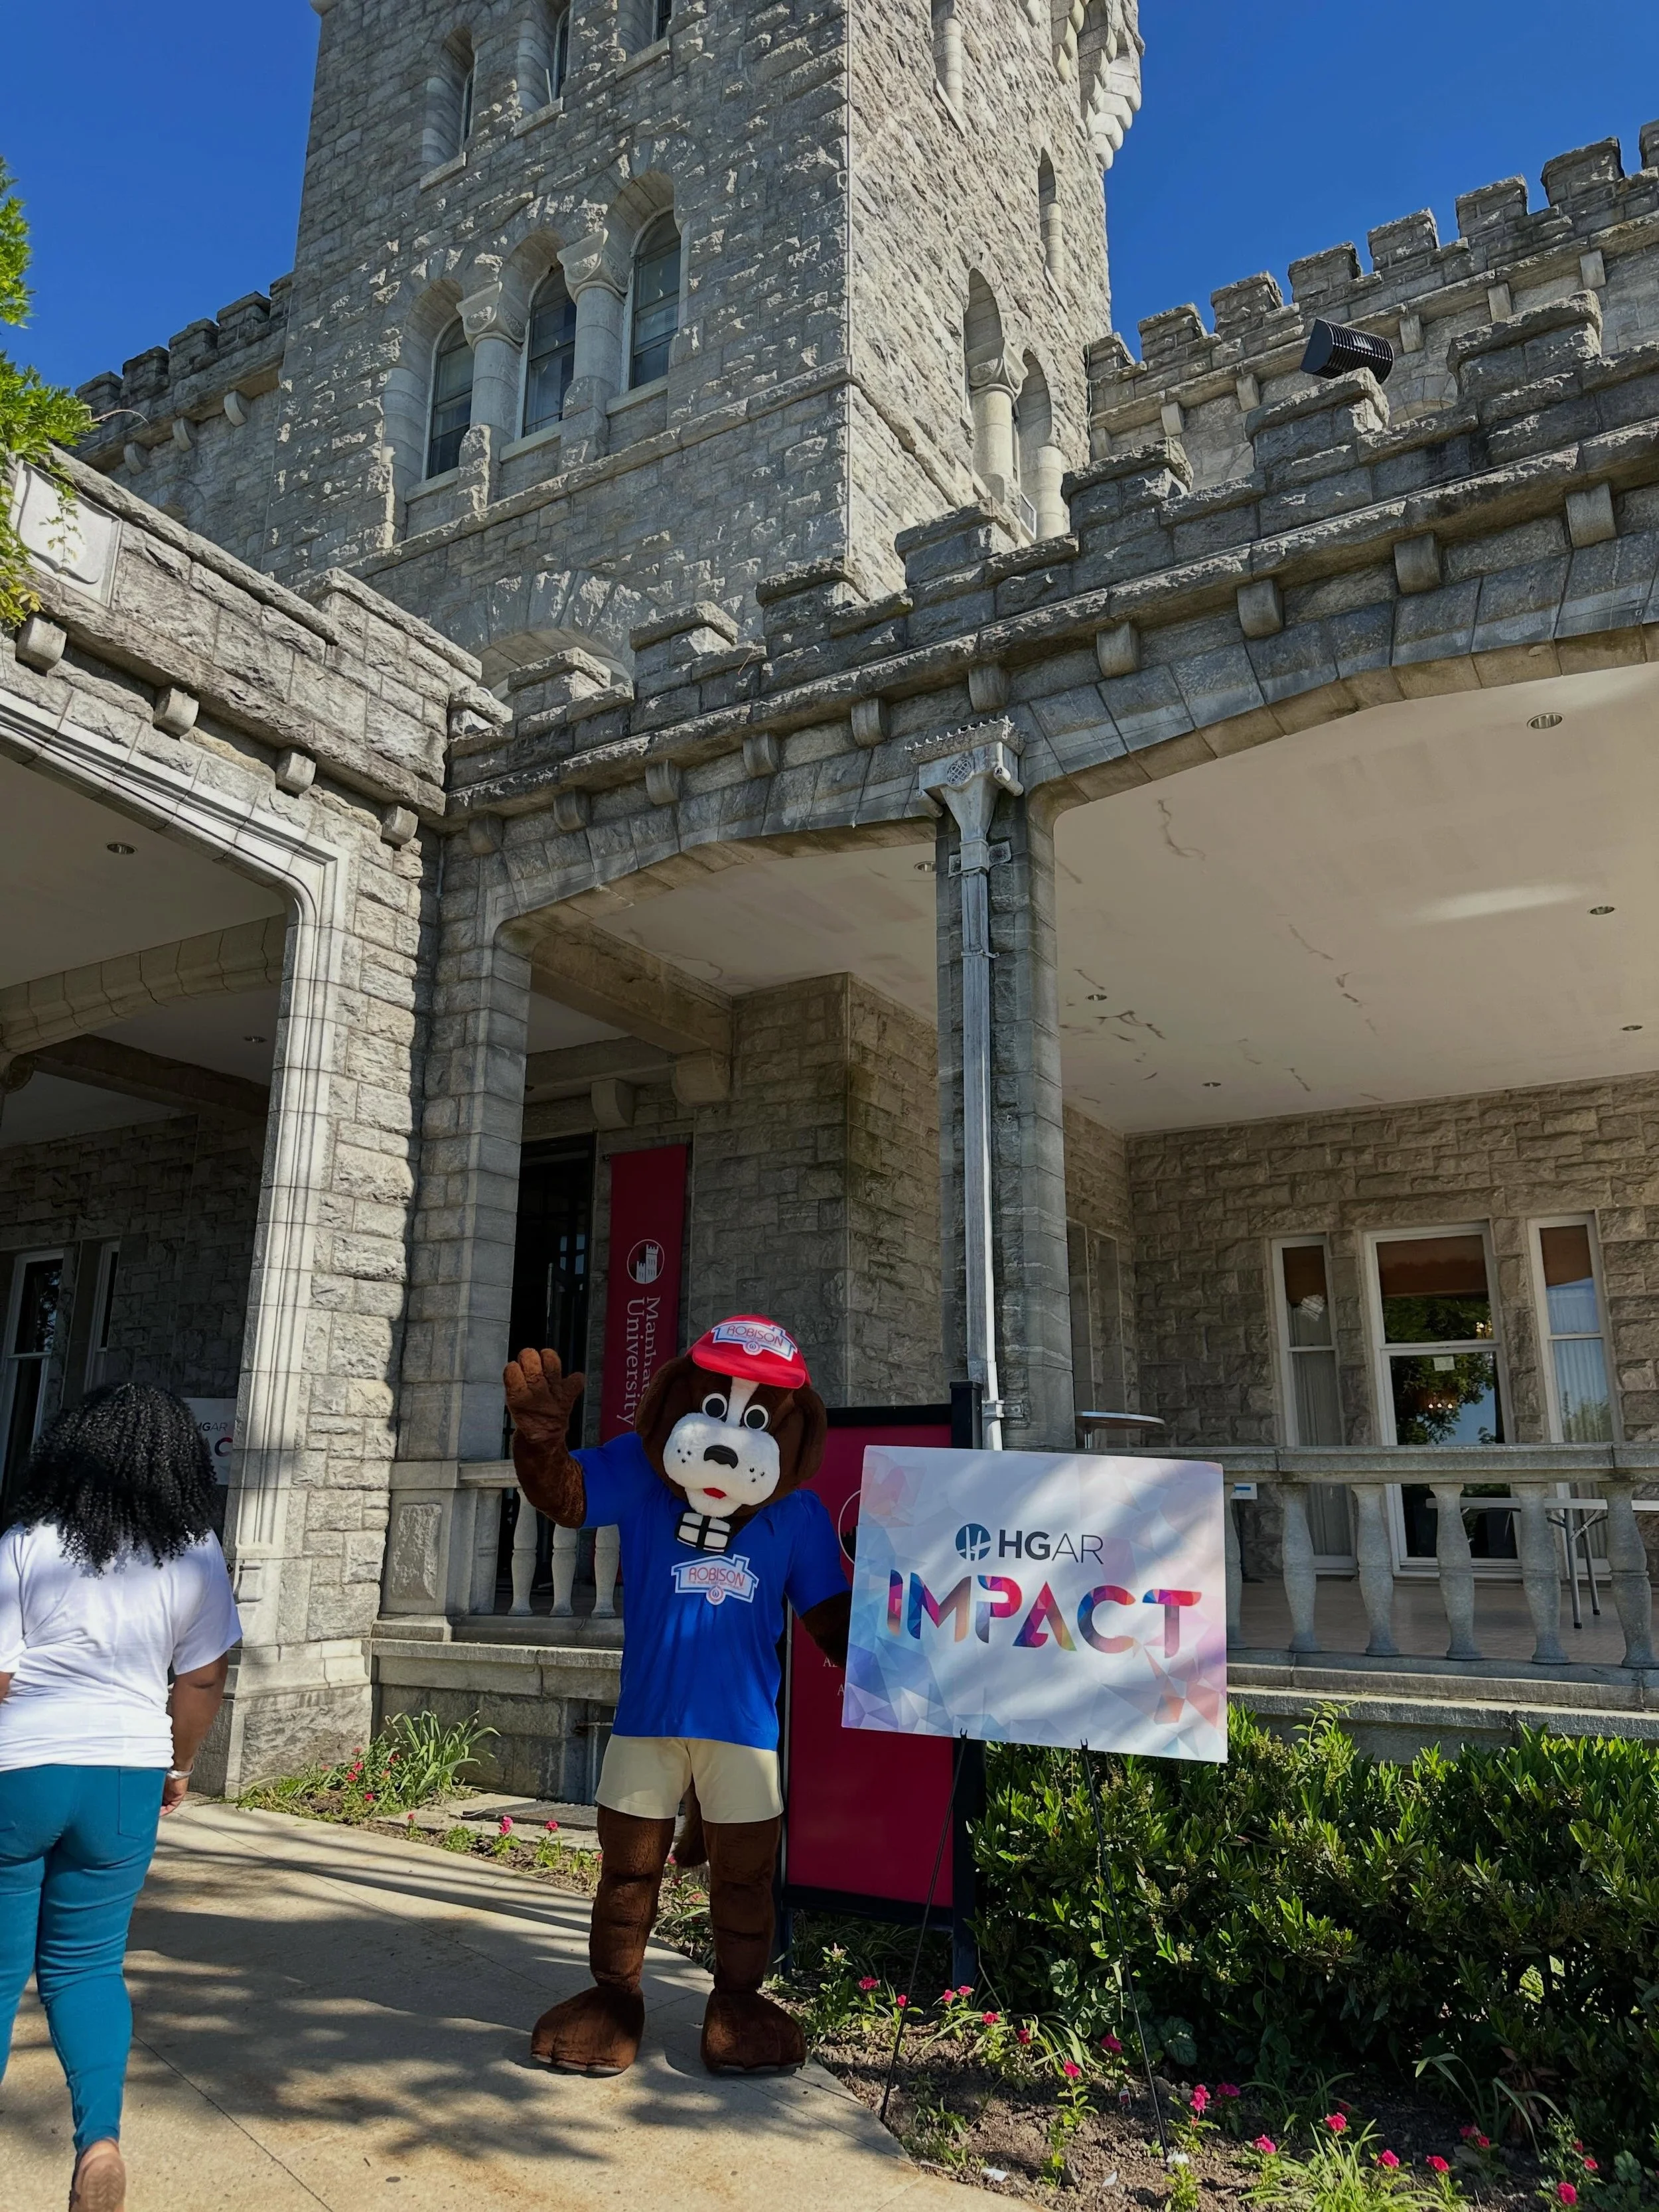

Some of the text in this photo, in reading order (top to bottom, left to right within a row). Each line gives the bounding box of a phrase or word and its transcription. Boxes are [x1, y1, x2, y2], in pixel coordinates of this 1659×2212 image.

[616, 1297, 645, 1426] University
[640, 1295, 661, 1399] Manhat
[727, 1325, 783, 1347] ROBISON
[688, 1566, 745, 1587] ROBISON
[998, 1528, 1104, 1565] HGAR
[886, 1568, 1202, 1659] IMPACT
